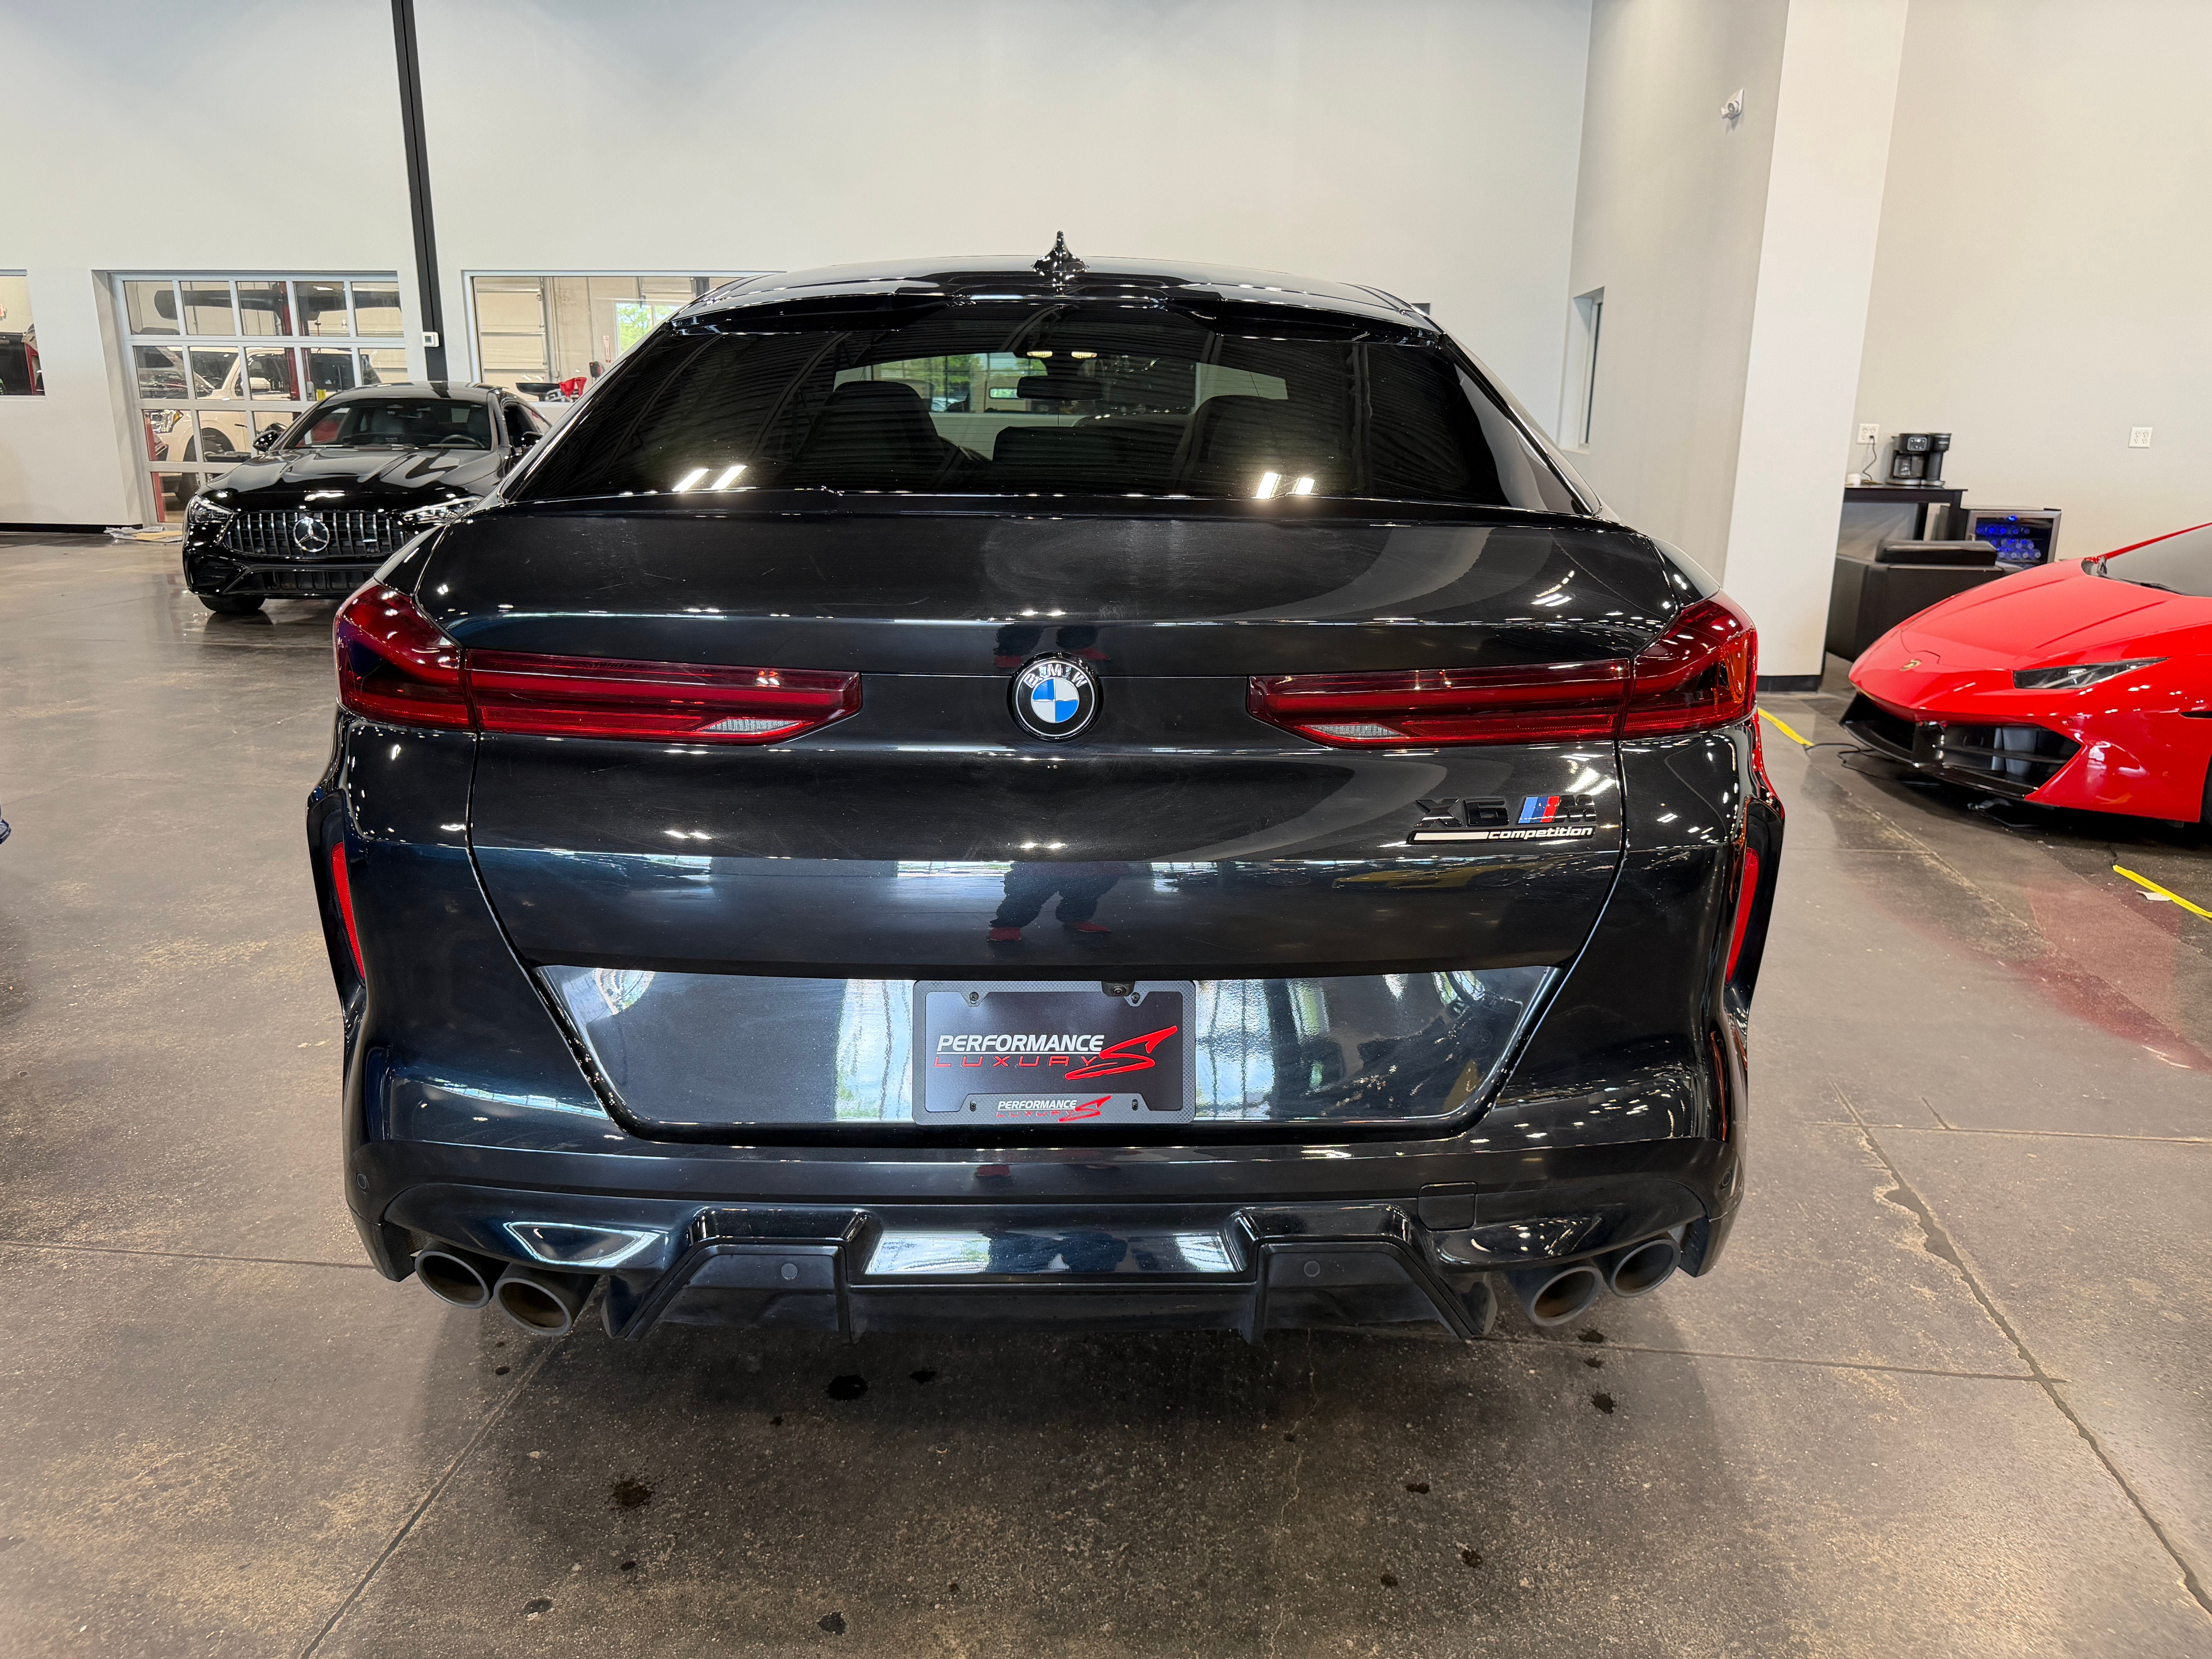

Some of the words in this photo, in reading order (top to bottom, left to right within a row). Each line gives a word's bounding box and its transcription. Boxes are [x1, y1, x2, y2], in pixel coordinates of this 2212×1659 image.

[1024, 663, 1088, 688] BMW
[1414, 798, 1509, 828] X6
[1488, 826, 1593, 840] competition
[937, 1034, 1105, 1052] PERFORMANCE
[933, 1056, 1097, 1068] LUXURY
[997, 1099, 1077, 1109] PERFORMANCE
